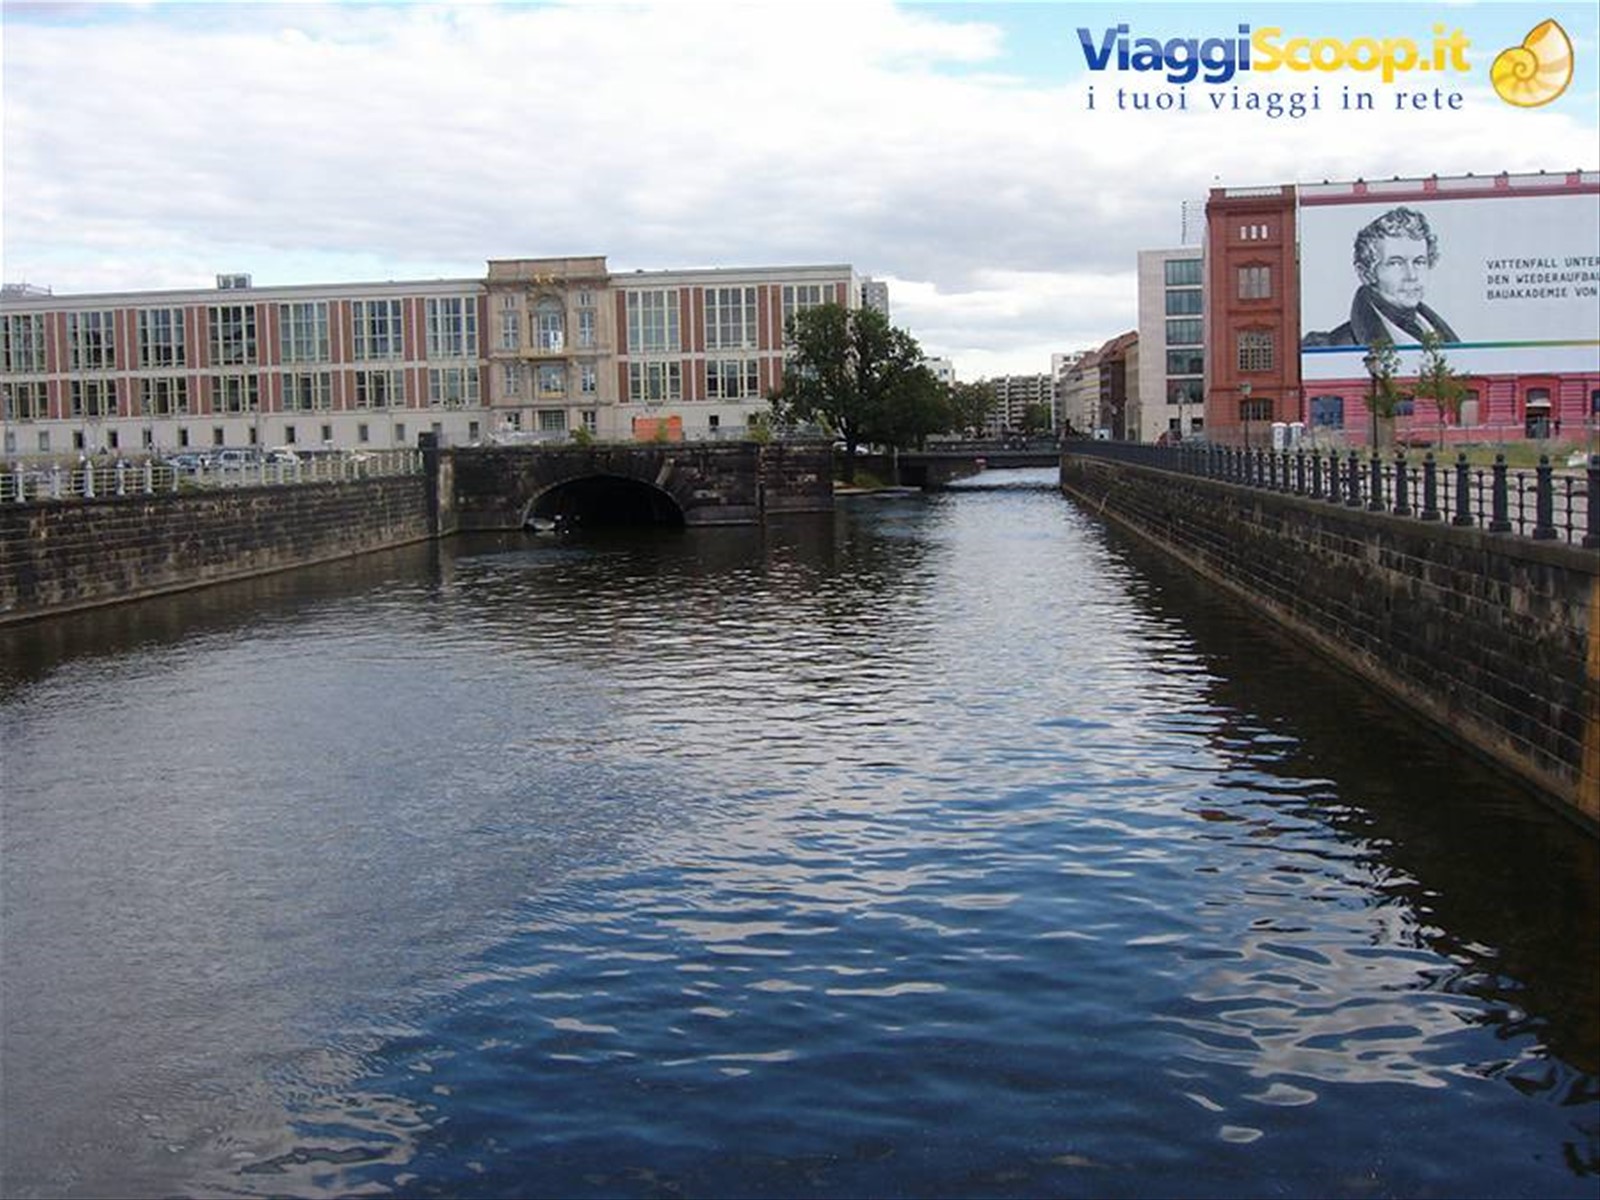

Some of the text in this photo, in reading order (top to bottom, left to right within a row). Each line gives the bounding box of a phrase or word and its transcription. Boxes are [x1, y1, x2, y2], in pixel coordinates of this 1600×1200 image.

[1486, 258, 1558, 270] VATTENFALL
[1487, 274, 1509, 285] DEN
[1487, 286, 1598, 300] BAUAKADEMIE VON
